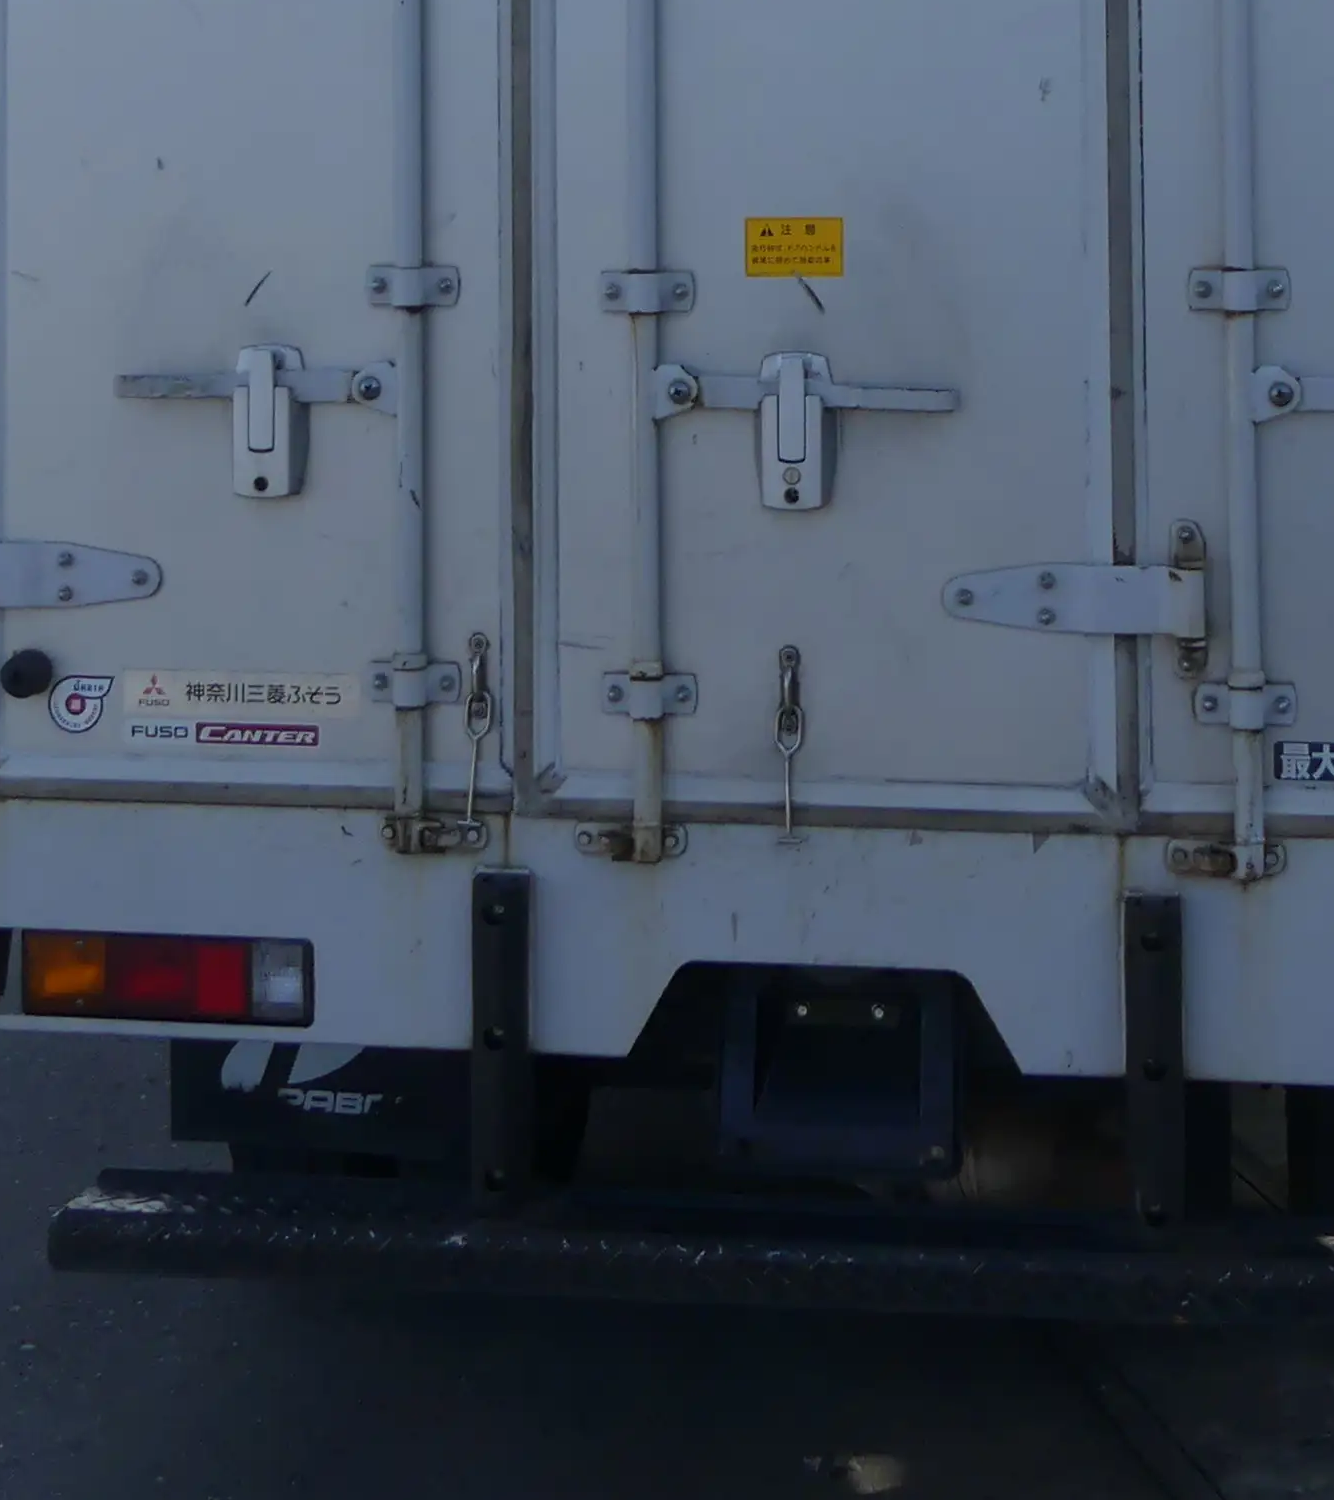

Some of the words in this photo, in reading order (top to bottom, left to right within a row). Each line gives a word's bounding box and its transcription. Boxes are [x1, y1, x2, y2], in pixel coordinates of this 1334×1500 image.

[138, 698, 170, 707] FUSO
[185, 681, 342, 706] 神奈川三菱ふそう
[130, 725, 189, 739] FUSO
[198, 726, 316, 744] CANTER
[277, 1087, 403, 1116] PAB
